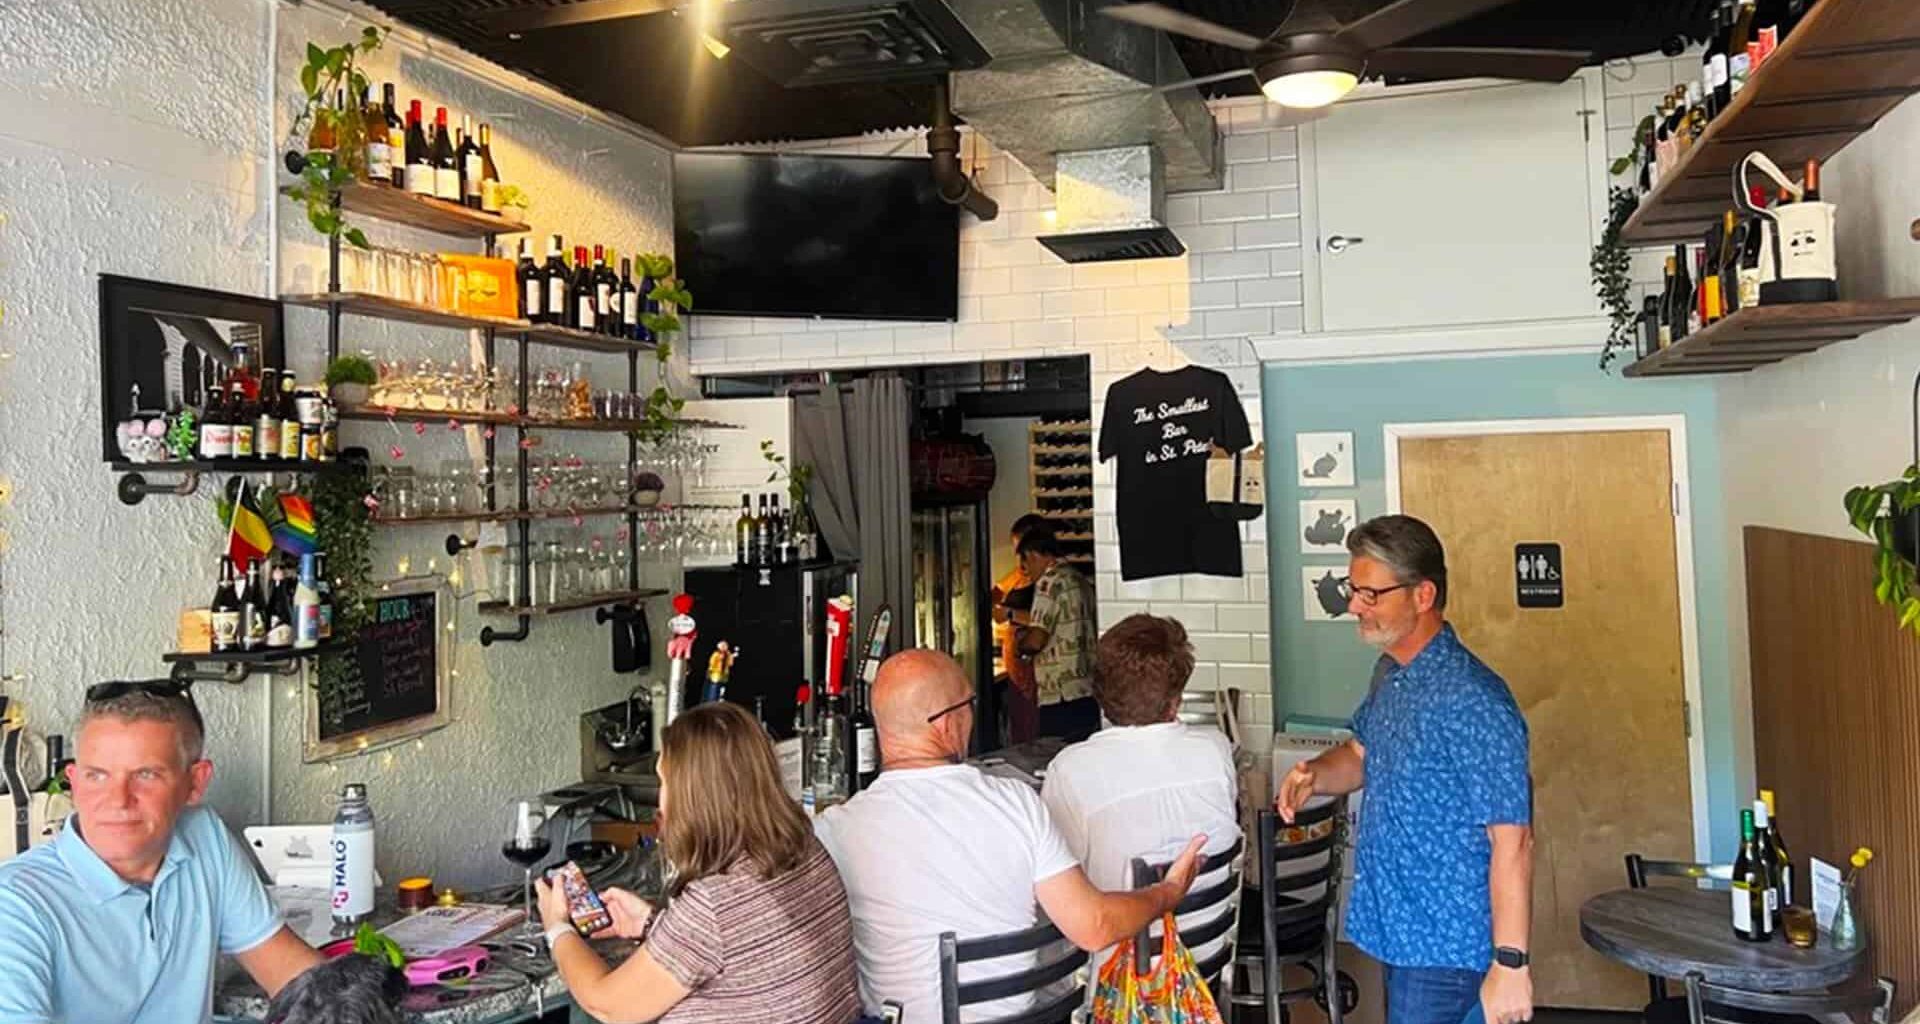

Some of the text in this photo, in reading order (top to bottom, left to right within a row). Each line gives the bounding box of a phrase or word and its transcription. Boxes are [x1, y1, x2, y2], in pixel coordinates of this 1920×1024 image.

[1133, 397, 1210, 425] The Smallest
[1161, 422, 1189, 440] Bar
[1145, 451, 1158, 463] in
[335, 839, 347, 887] HALO
